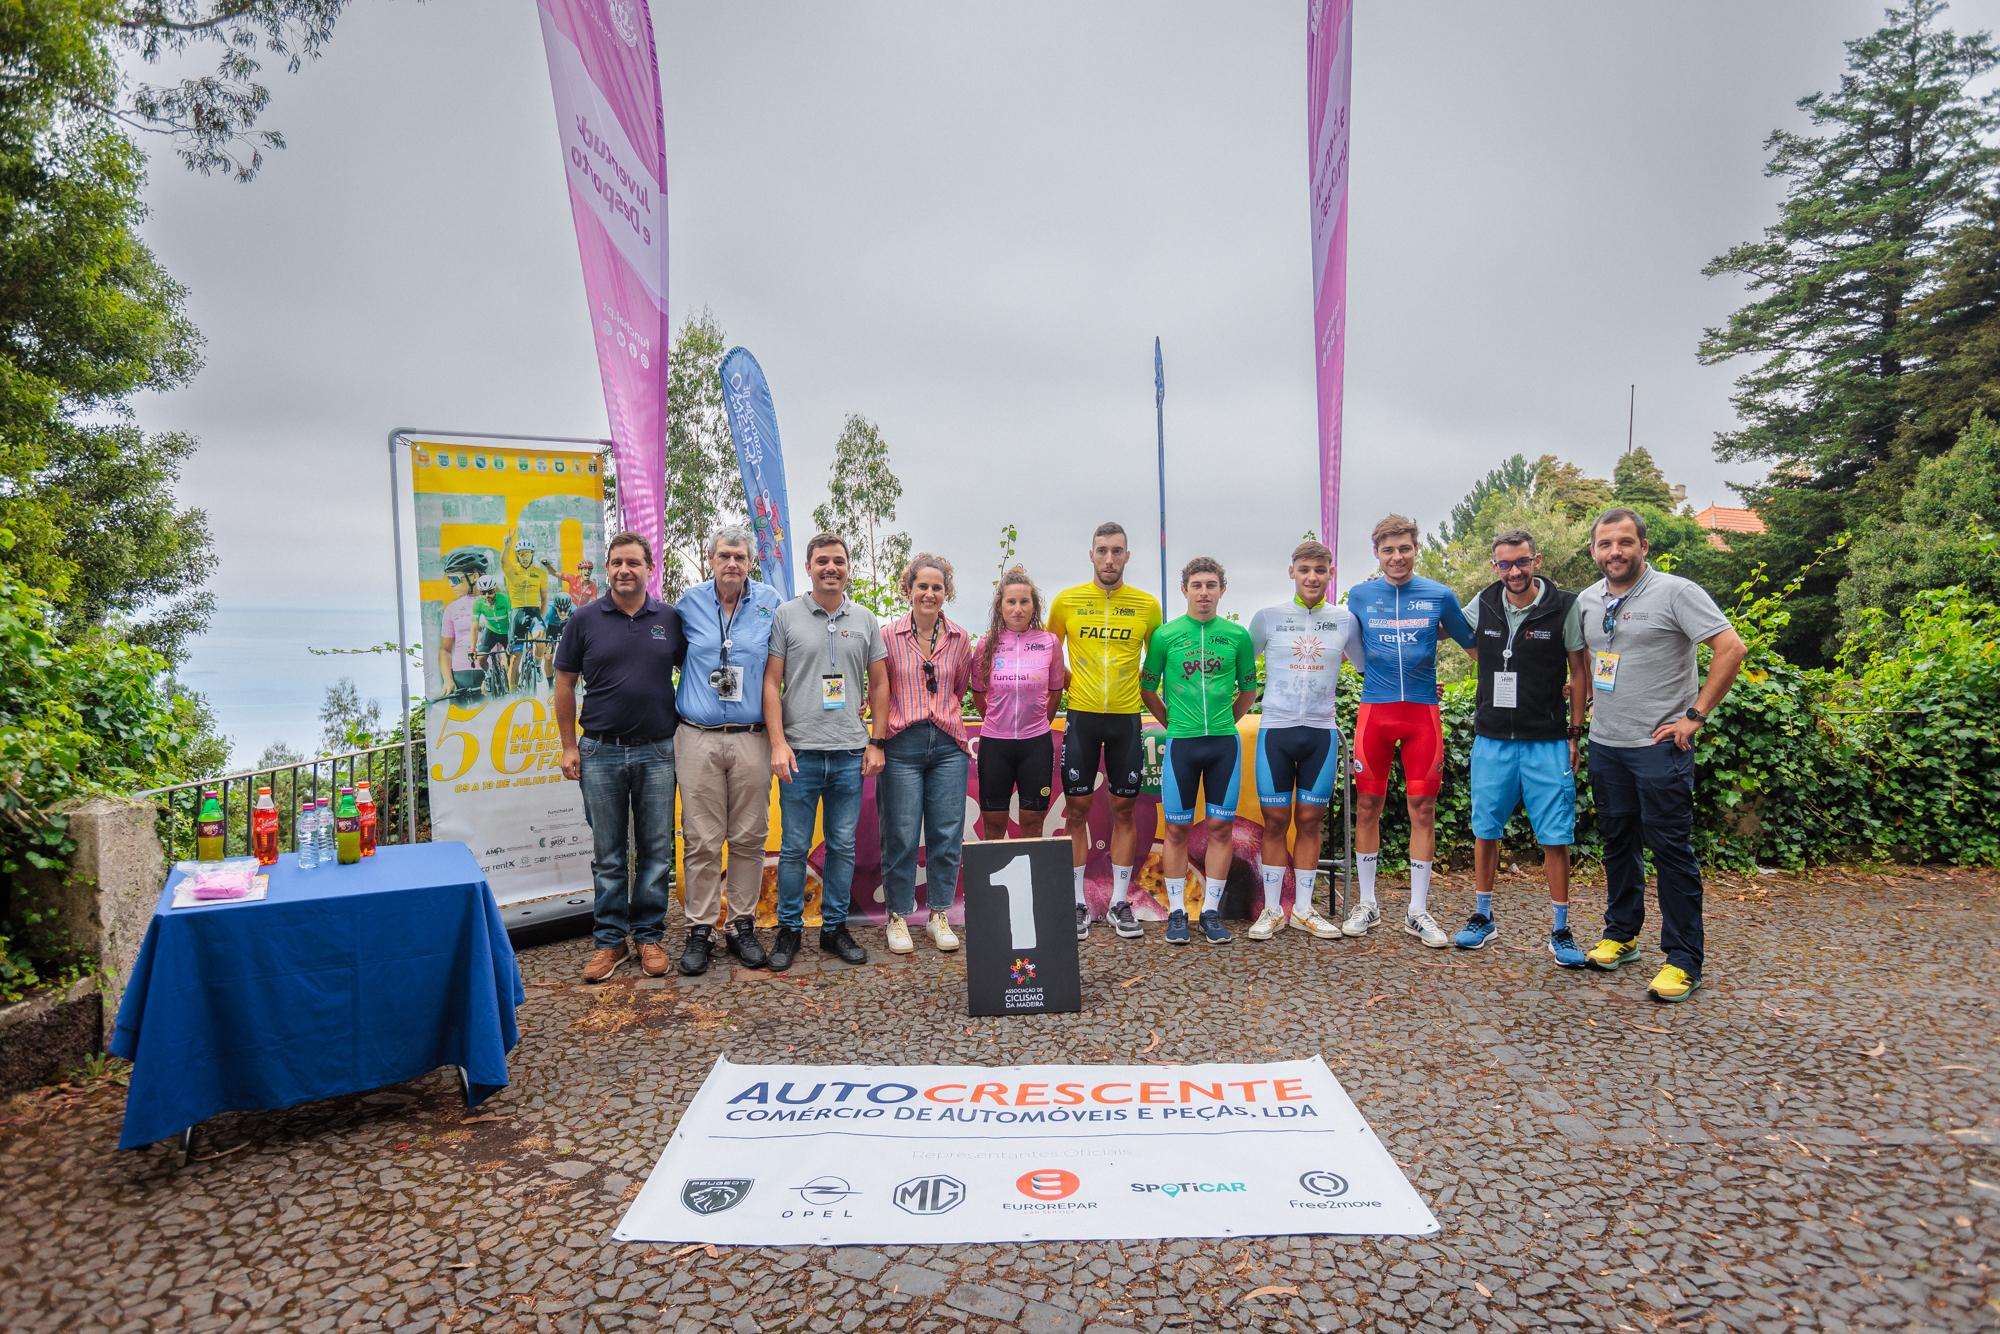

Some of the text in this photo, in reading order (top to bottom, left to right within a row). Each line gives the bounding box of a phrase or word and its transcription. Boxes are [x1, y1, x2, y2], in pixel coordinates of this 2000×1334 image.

[1079, 626, 1132, 641] FACCO
[1378, 630, 1419, 643] rentX
[1182, 657, 1222, 676] BRISA
[993, 673, 1029, 681] funchal
[512, 776, 546, 787] JULHO
[989, 854, 1037, 950] 1
[1005, 993, 1044, 1002] CICLISMO
[726, 1106, 884, 1122] COMÉRCIO
[893, 1106, 932, 1121] DE
[937, 1106, 1128, 1123] AUTOMÓVEIS
[1138, 1107, 1154, 1120] E
[1262, 1104, 1318, 1118] LDA
[912, 1150, 1058, 1161] Representantes
[899, 1179, 959, 1211] MG
[1002, 1202, 1098, 1210] EUROREPAR
[1289, 1199, 1382, 1209] Free2move
[781, 1210, 853, 1218] OPEL
